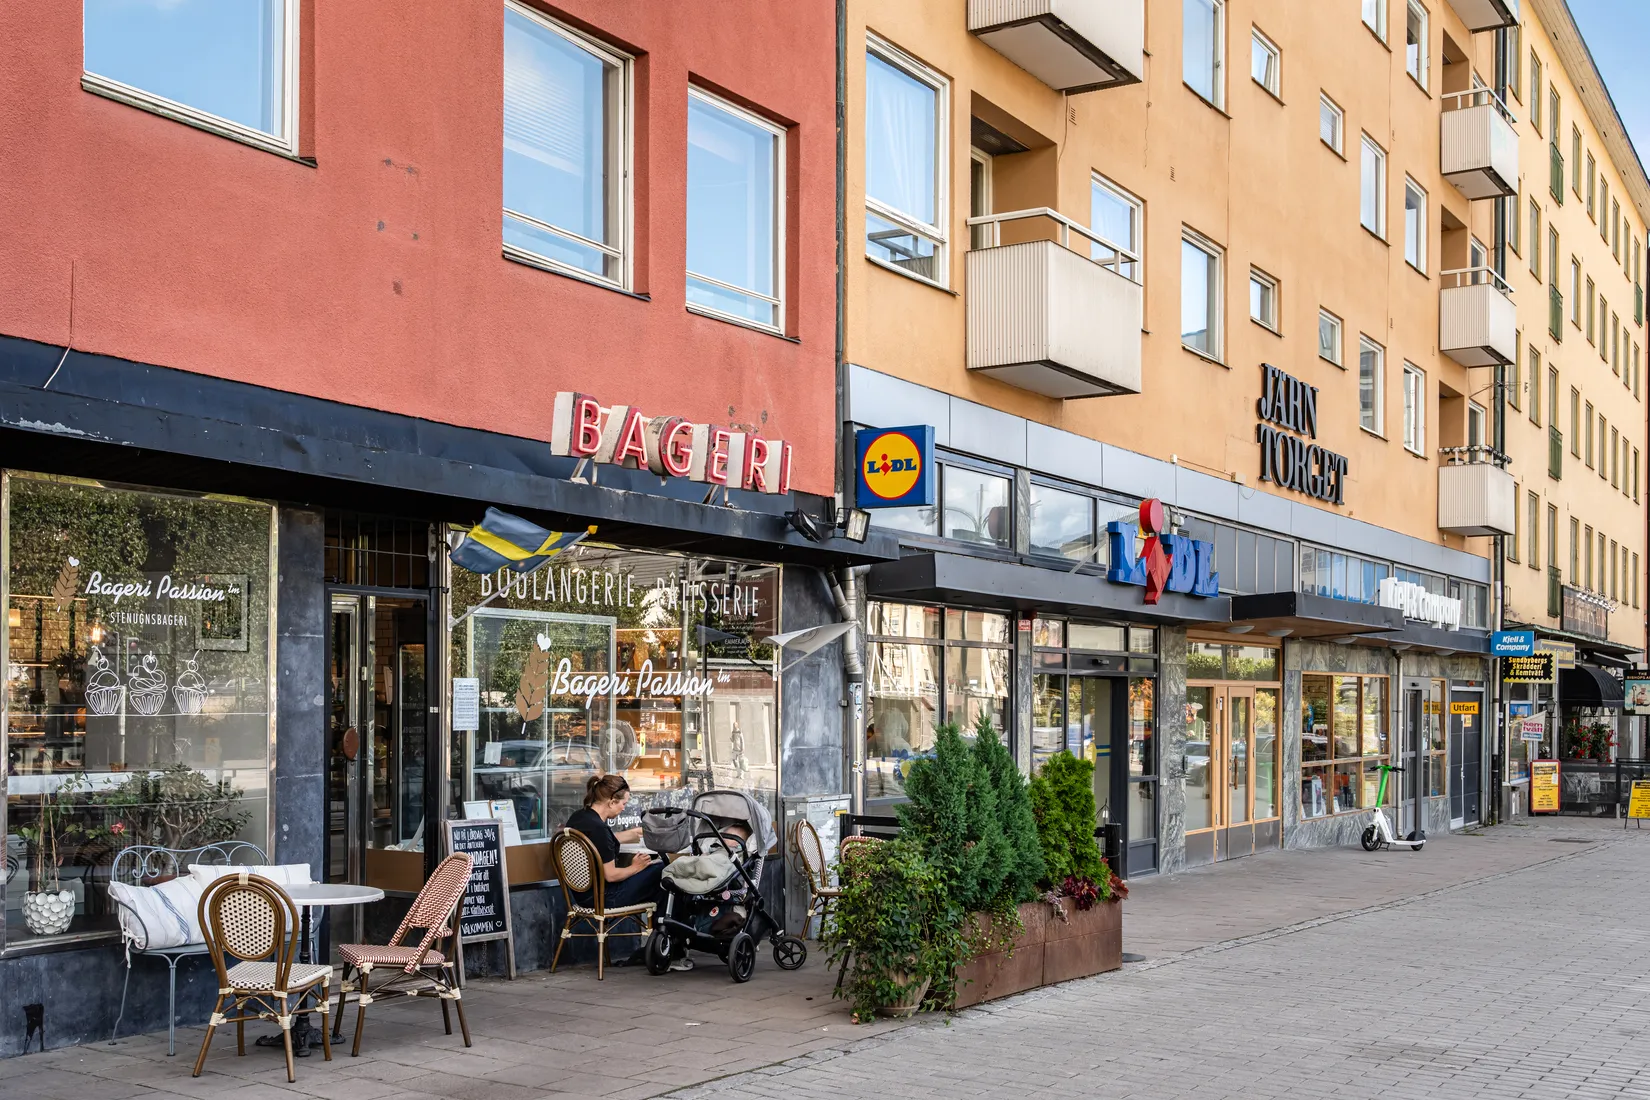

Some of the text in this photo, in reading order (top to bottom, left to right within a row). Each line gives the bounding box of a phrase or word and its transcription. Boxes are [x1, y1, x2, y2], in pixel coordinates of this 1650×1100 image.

[1257, 363, 1319, 440] JÄRN
[551, 391, 792, 496] BAGERI
[1256, 423, 1348, 506] TORGET
[84, 571, 152, 604] Bageri
[156, 575, 226, 602] Passion
[481, 566, 635, 608] BOULANGERIE
[657, 571, 760, 618] PÂTISSERIE
[110, 612, 188, 627] STENUGNSBAGERI
[1495, 644, 1530, 652] Company
[1502, 635, 1525, 643] Kjell &
[550, 658, 631, 709] Bageri
[636, 658, 714, 698] Passion
[1453, 704, 1476, 712] Utfart
[461, 921, 494, 935] VÄLKOMMEN
